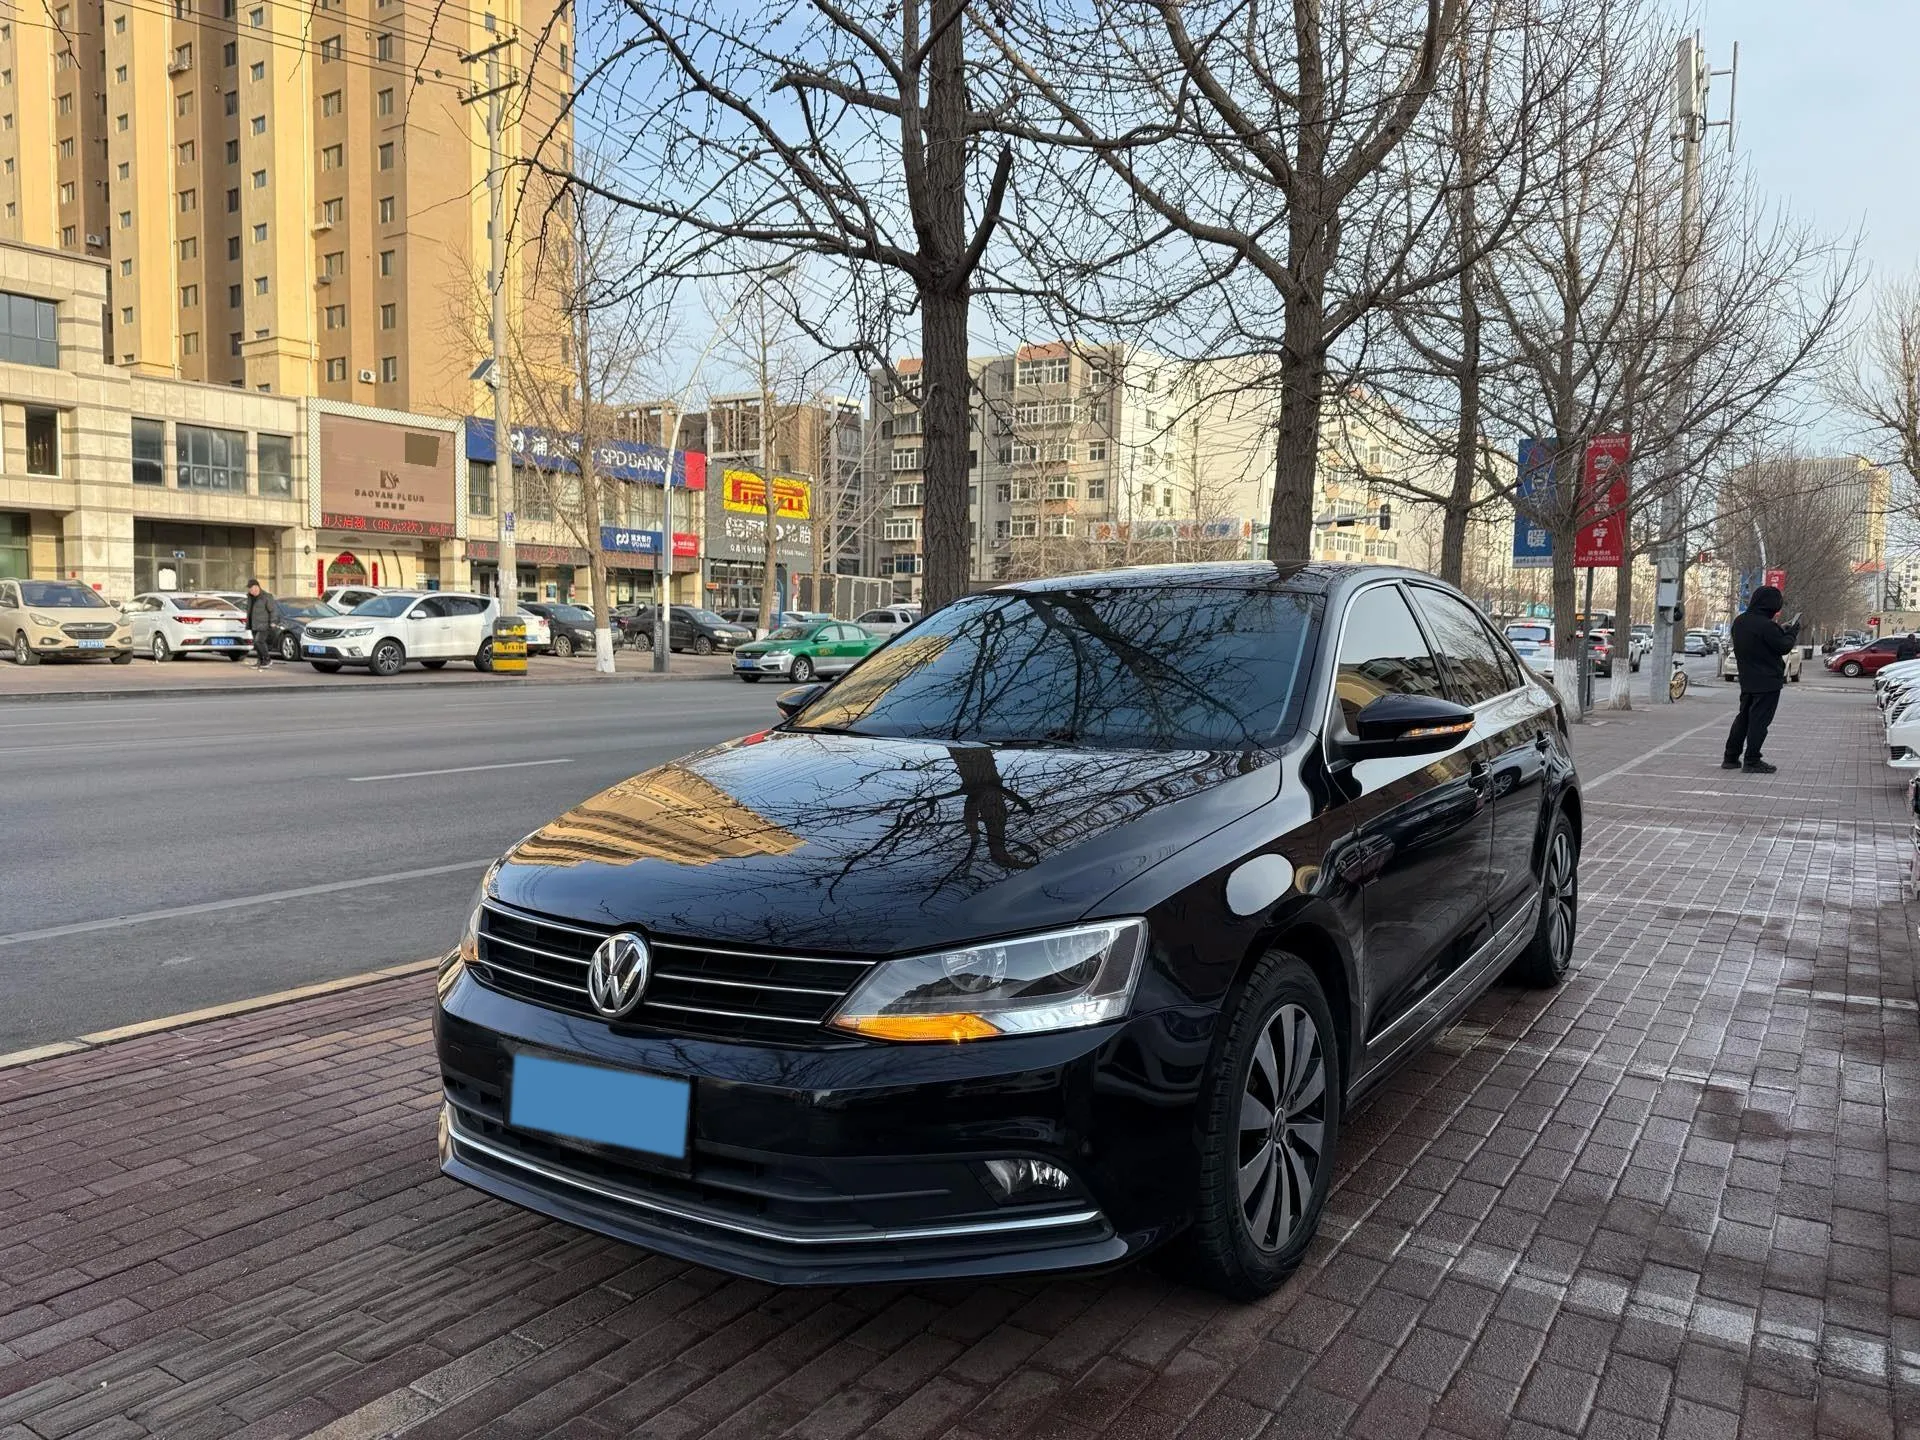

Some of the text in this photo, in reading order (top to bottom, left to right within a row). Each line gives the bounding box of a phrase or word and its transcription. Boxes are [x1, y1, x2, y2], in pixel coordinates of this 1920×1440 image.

[532, 435, 666, 473] 浦发银 SPD BANK
[731, 479, 805, 512] PIRLLI
